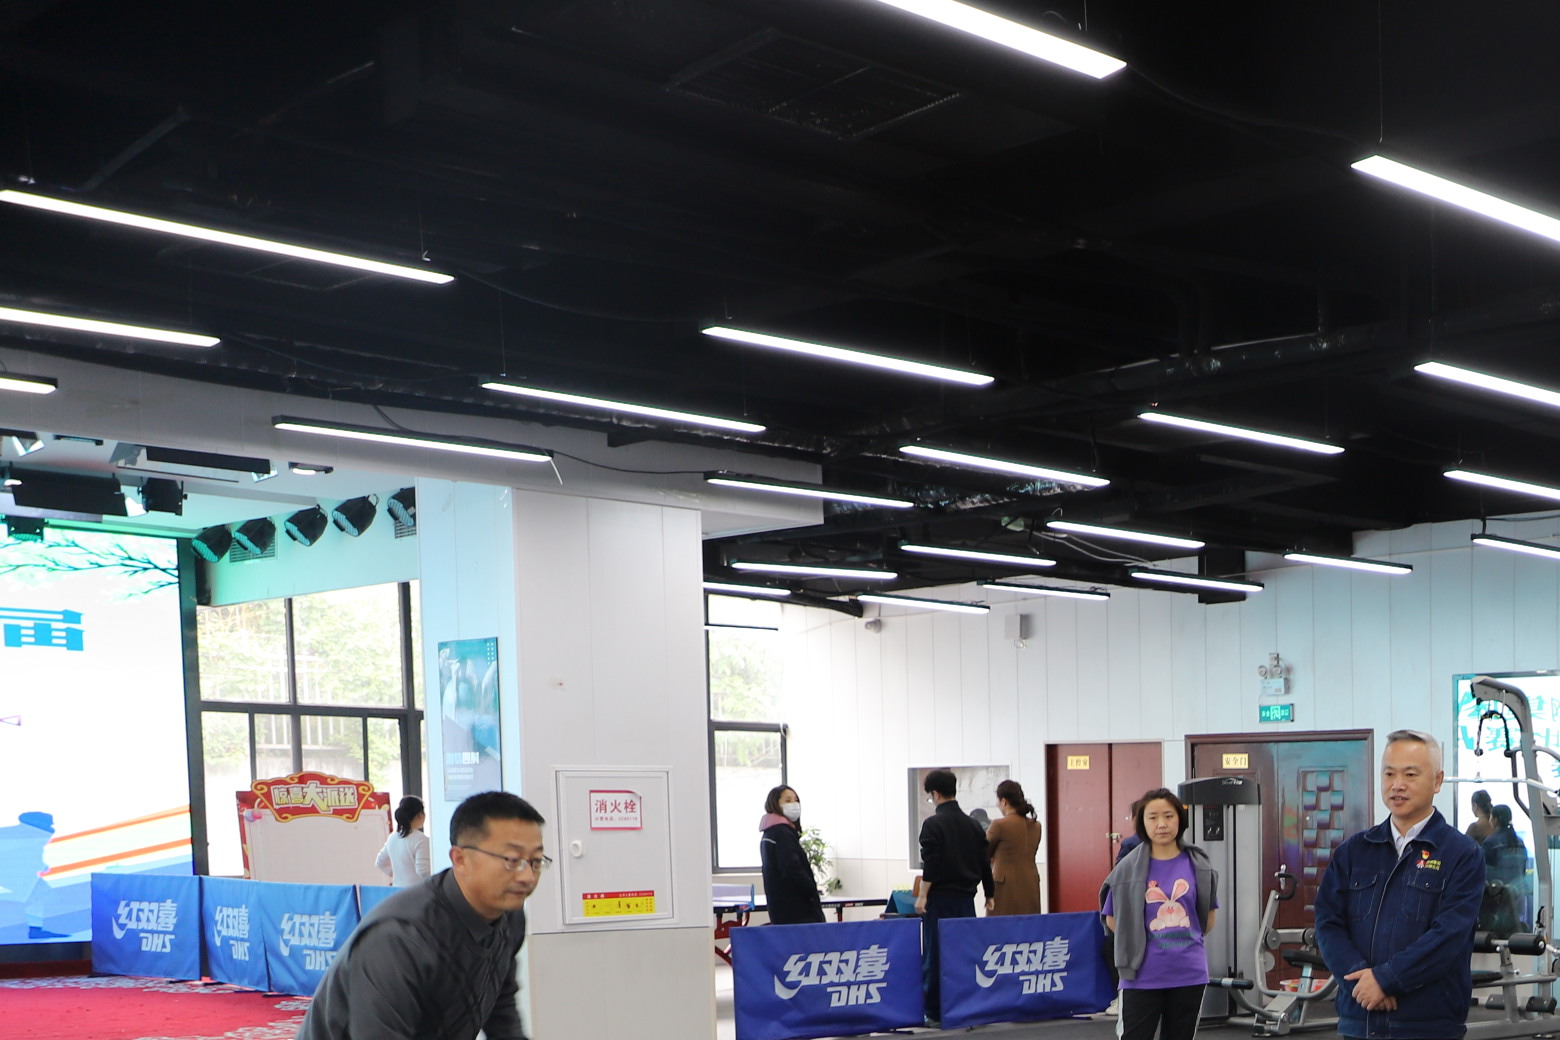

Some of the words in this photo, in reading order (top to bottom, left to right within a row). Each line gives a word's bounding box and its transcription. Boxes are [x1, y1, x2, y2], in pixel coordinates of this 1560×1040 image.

[1224, 756, 1247, 767] 安全门
[272, 782, 357, 812] 惊喜大派送
[595, 799, 636, 813] 消火栓
[112, 899, 178, 940] 红双喜
[214, 904, 250, 947] 红双喜
[139, 932, 175, 953] DHS
[280, 911, 337, 957] 红双喜
[231, 940, 249, 961] DHS
[975, 936, 1071, 988] 红双喜
[774, 944, 891, 1000] 红双喜
[1019, 972, 1067, 995] DHS
[826, 982, 887, 1008] DHS
